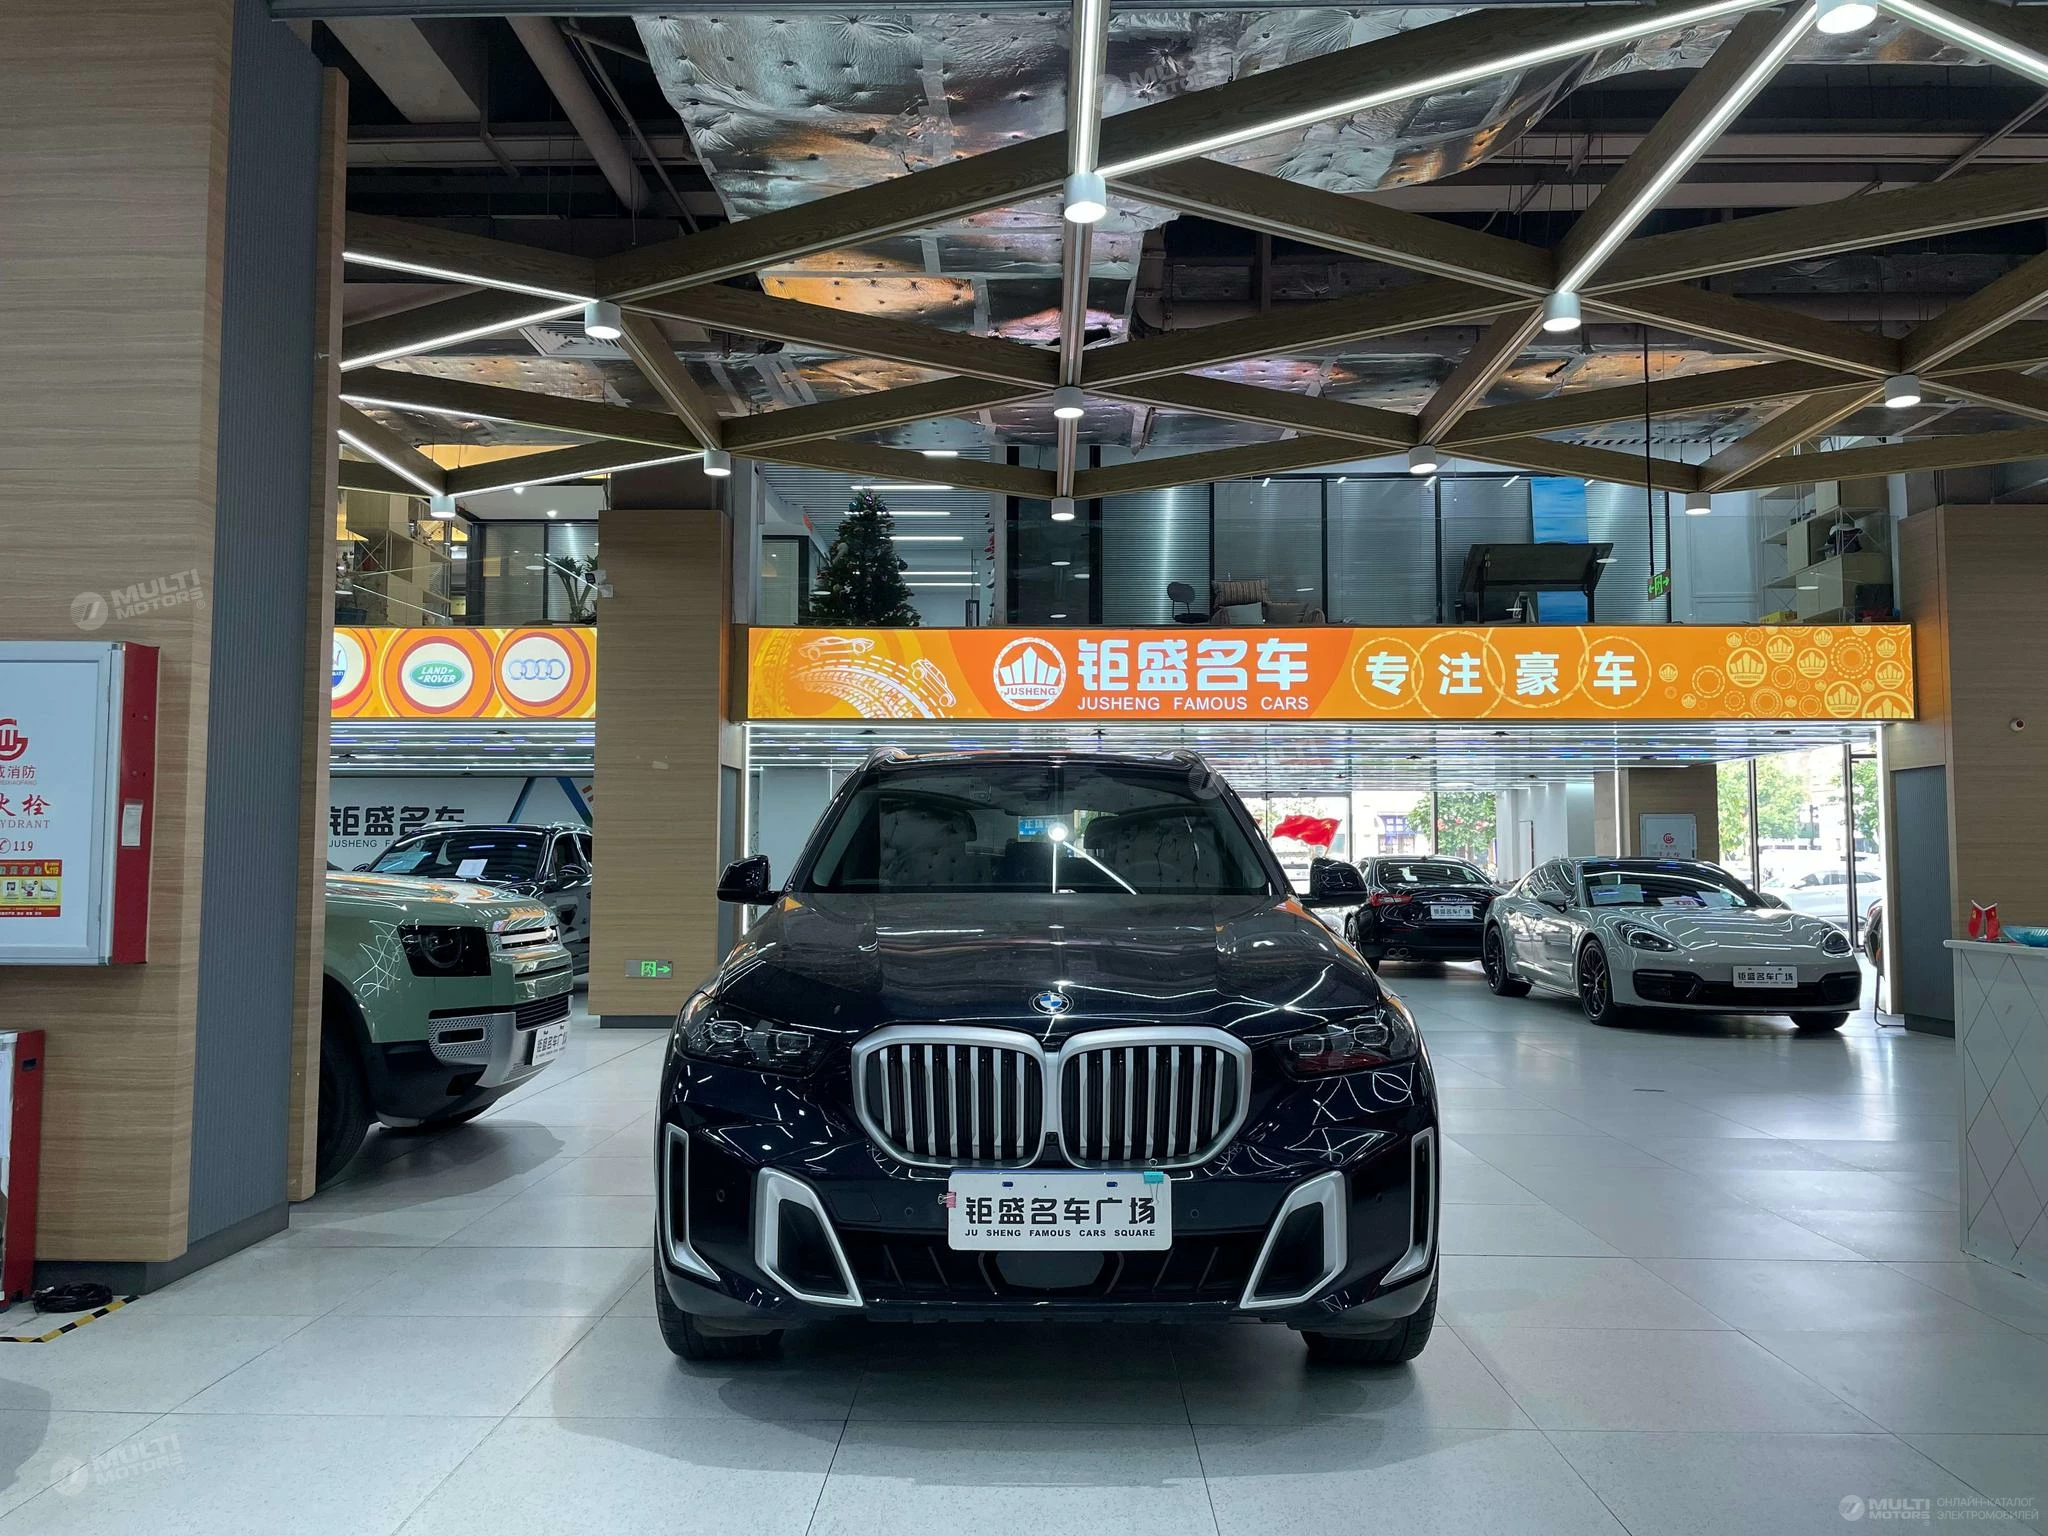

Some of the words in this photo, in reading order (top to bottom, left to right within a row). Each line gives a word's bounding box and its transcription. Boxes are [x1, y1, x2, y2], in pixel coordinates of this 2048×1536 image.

[1077, 638, 1309, 691] 钜盛名车
[421, 666, 448, 675] LAND
[1365, 650, 1639, 696] 专注豪车
[424, 675, 456, 683] ROVER
[1004, 687, 1057, 696] JUSHENG
[1077, 696, 1160, 711] JUSHENG
[1173, 696, 1249, 711] FAMOUS
[1261, 696, 1310, 711] CARS
[14, 840, 34, 852] 119
[329, 839, 378, 848] JUSHENG
[1738, 972, 1793, 981] 钜盛名车广场
[965, 1197, 1156, 1225] 钜盛名车广场
[965, 1229, 978, 1237] JU
[986, 1229, 1021, 1237] SHENG
[1029, 1229, 1071, 1237] FAMOUS
[1079, 1229, 1106, 1237] CARS
[1114, 1229, 1156, 1237] SQUARE
